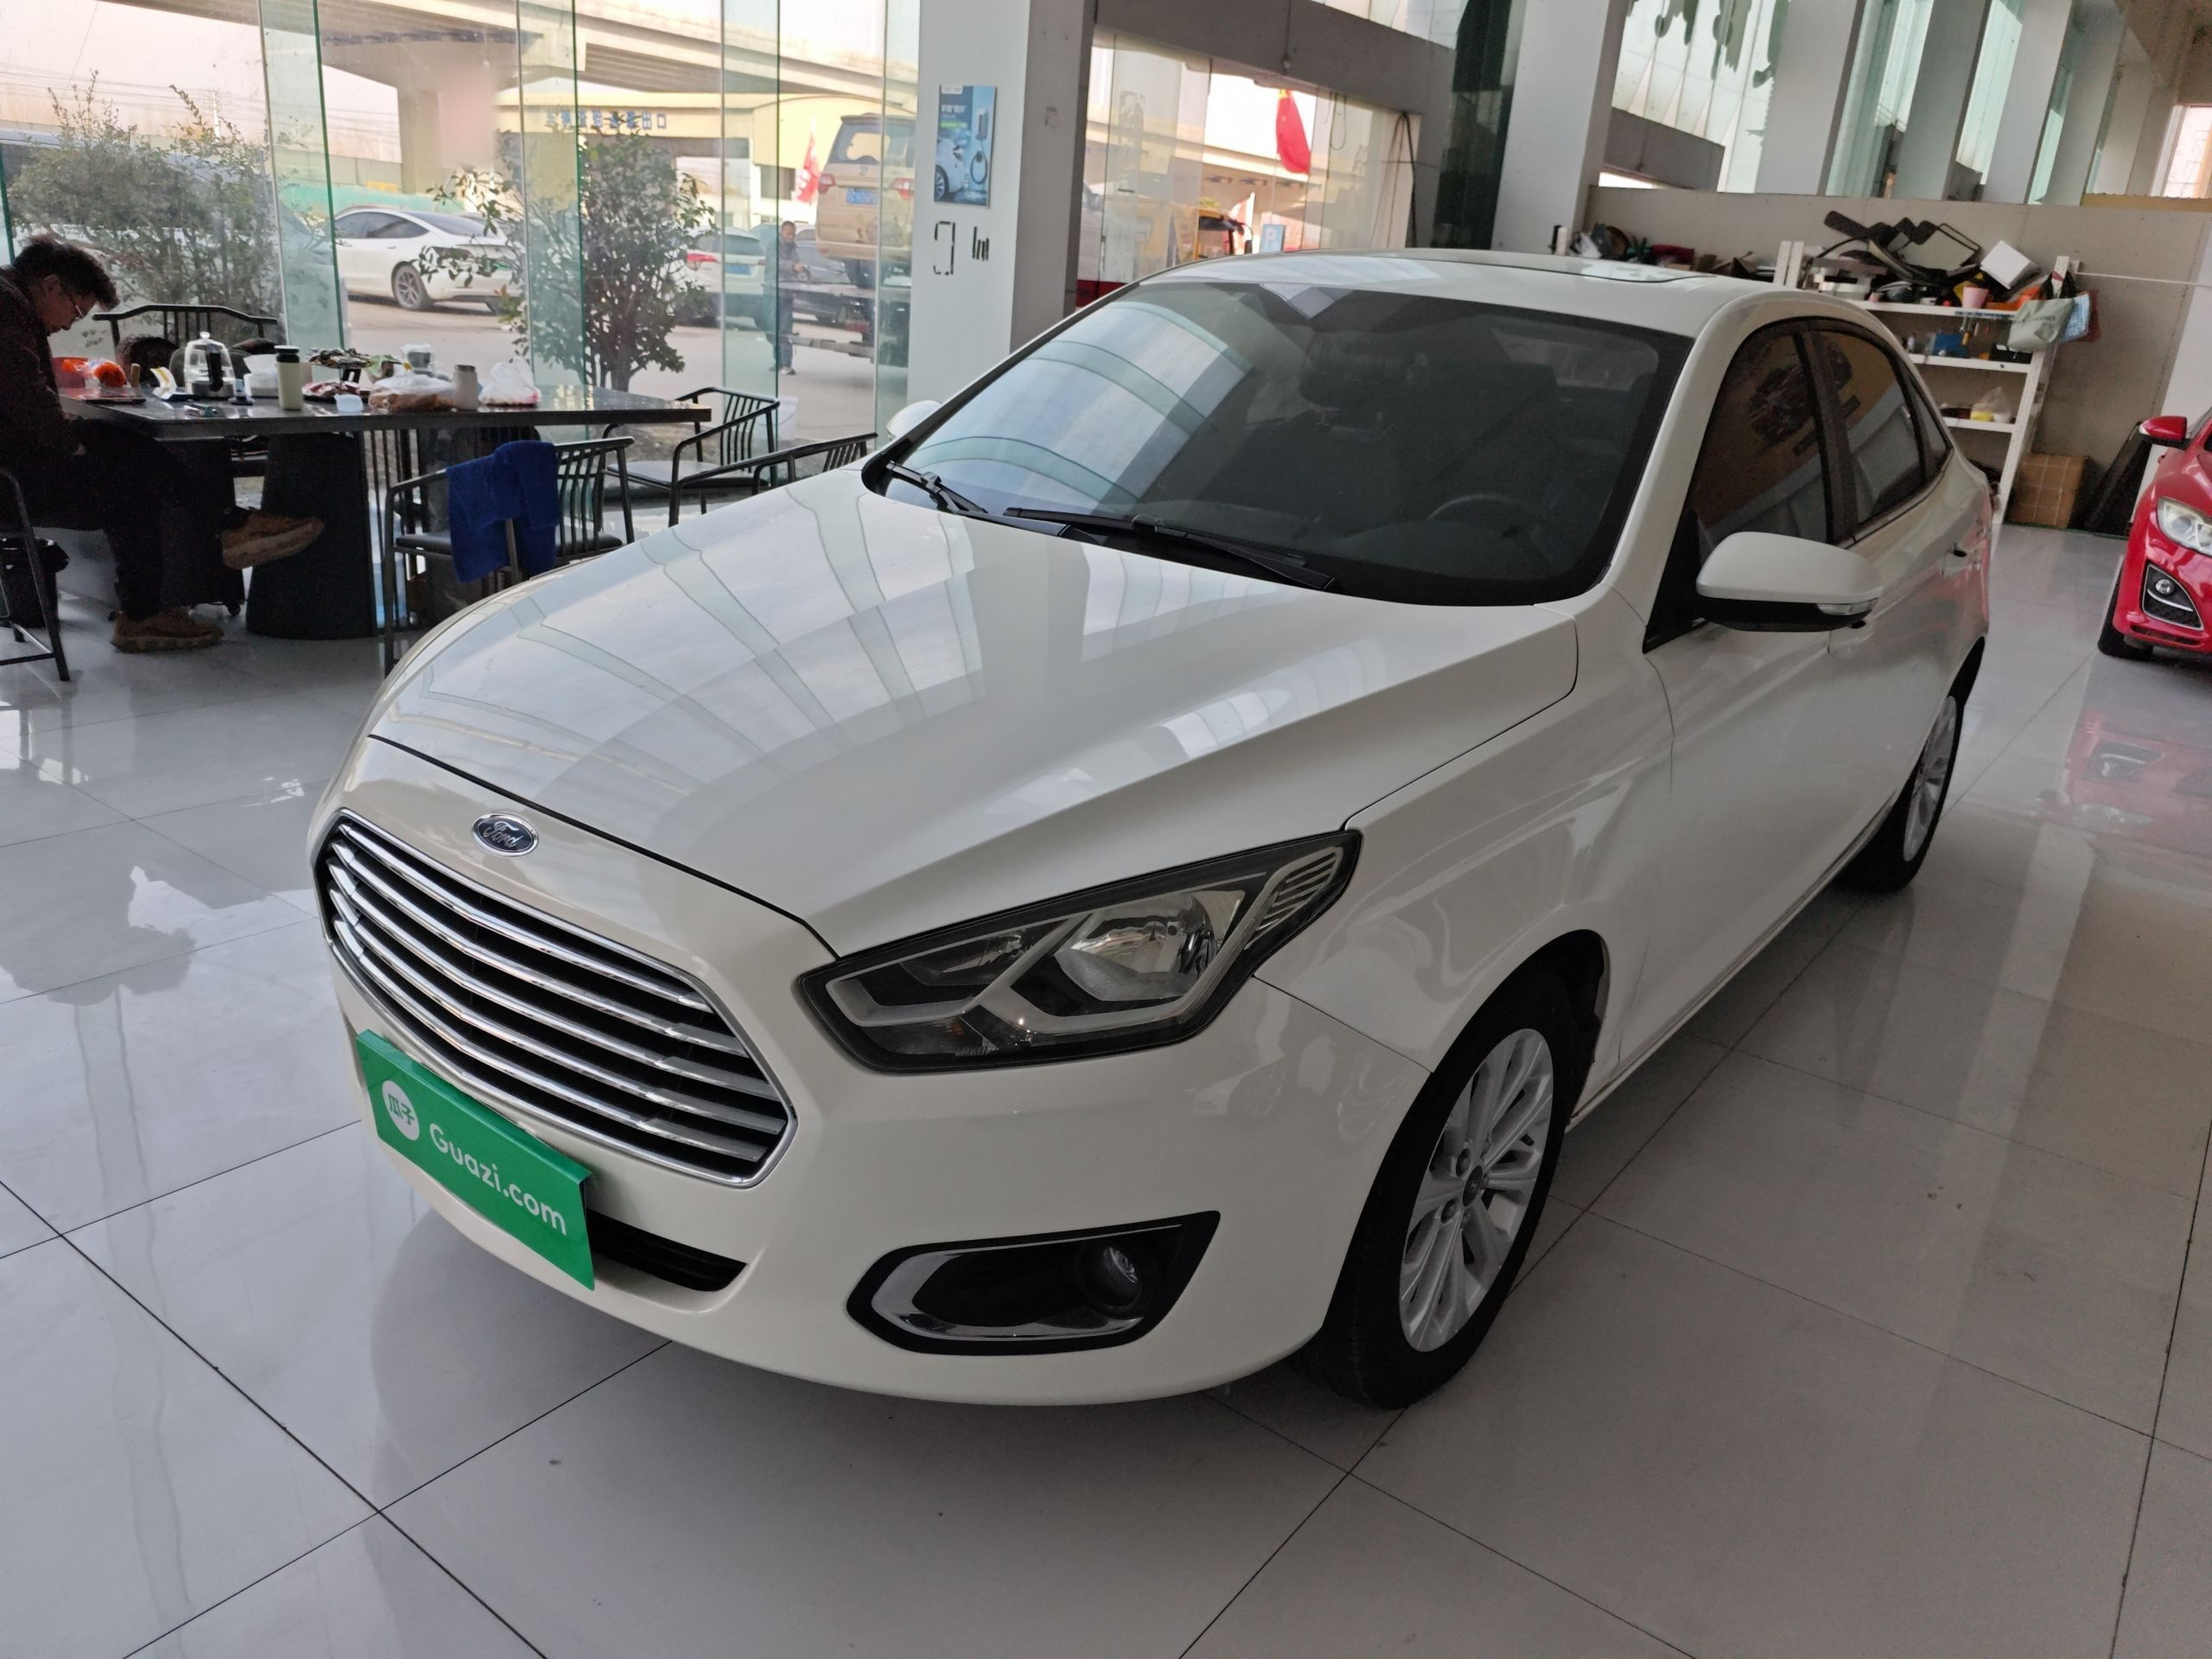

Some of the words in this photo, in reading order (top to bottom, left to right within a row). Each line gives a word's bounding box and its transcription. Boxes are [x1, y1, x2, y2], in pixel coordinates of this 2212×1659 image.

[483, 821, 525, 849] Ford
[388, 1093, 415, 1126] 瓜子
[429, 1123, 567, 1236] Guazi.com
